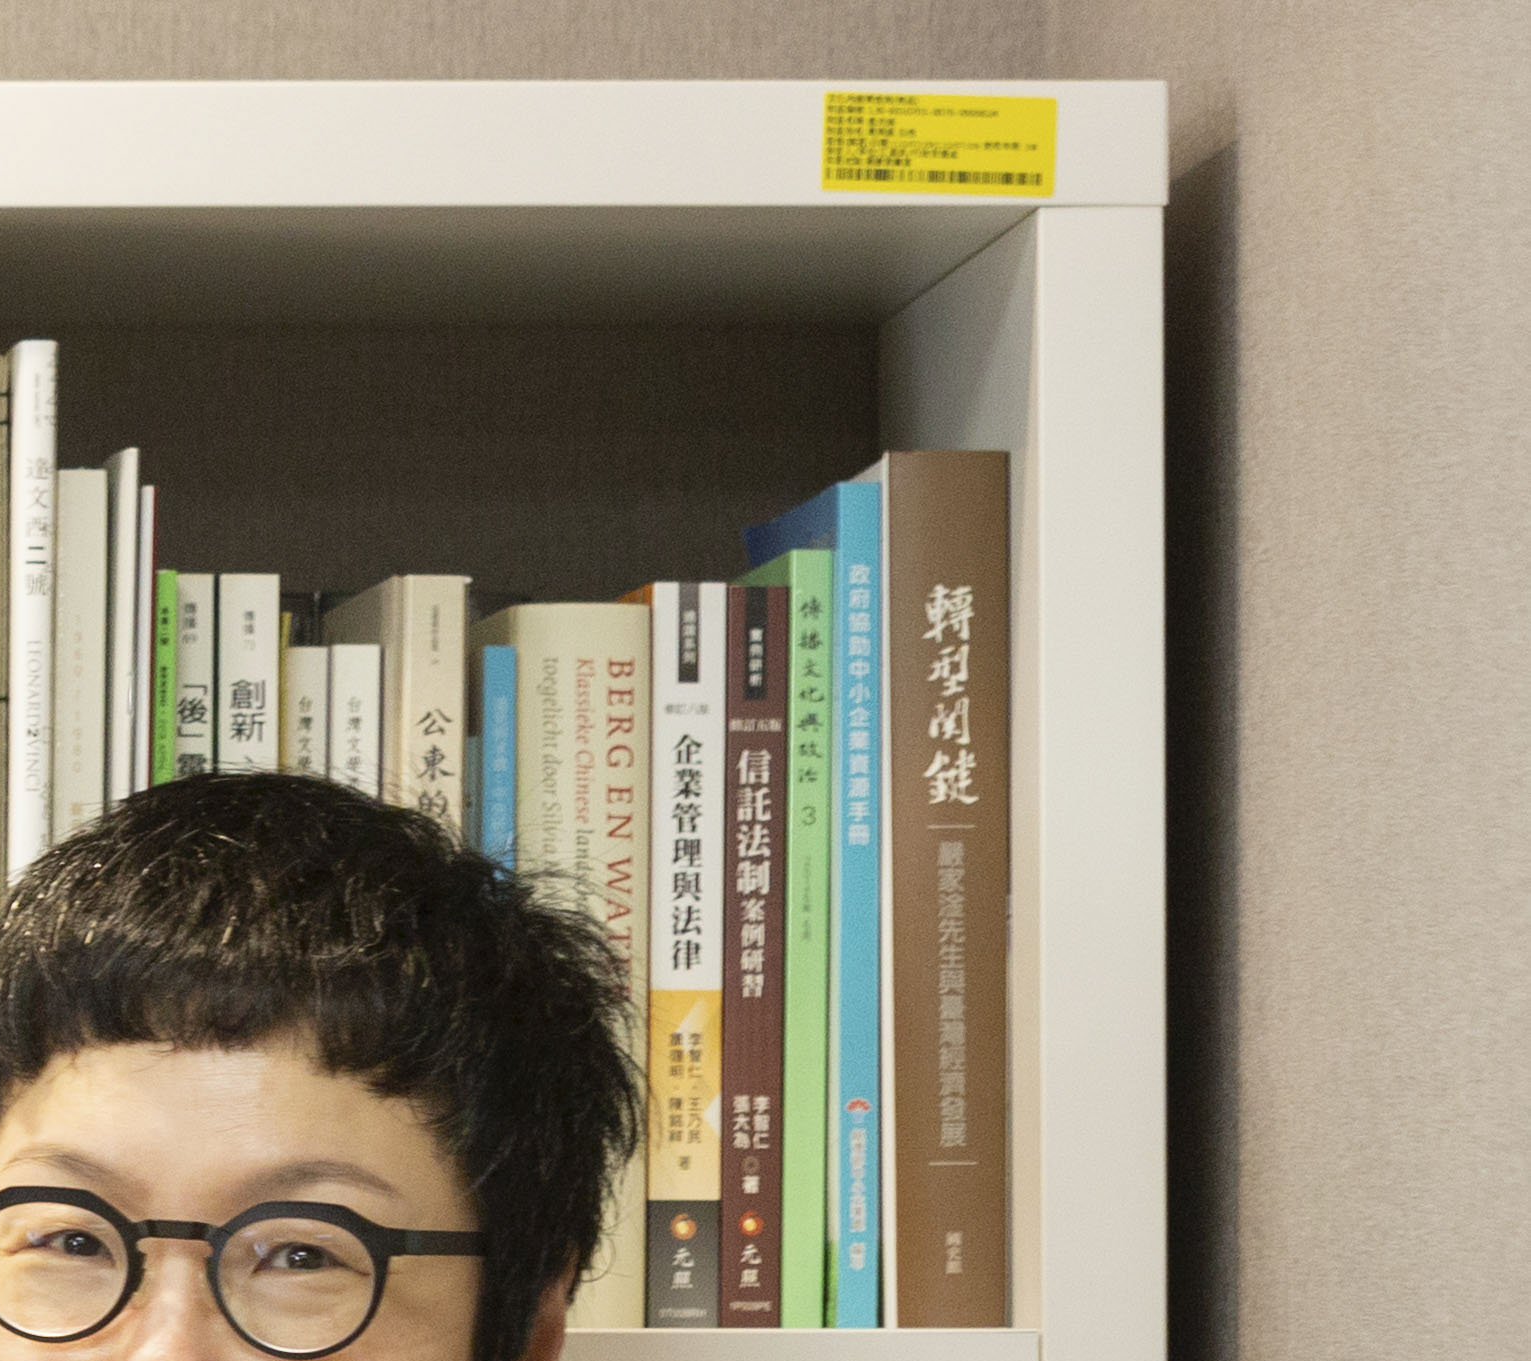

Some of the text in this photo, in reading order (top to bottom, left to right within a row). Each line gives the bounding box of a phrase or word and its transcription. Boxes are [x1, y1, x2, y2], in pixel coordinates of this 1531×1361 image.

[24, 457, 49, 598] 達文西二號
[414, 708, 456, 819] 公東的
[537, 657, 564, 854] toegelicht door Silvia
[573, 657, 597, 826] Klassieke Chinese
[606, 657, 637, 841] BERG EN
[847, 562, 872, 847] 政府協助中小企業資源手冊
[921, 583, 980, 805] 轉型關鍵
[671, 734, 704, 972] 企業管理與法律
[736, 749, 772, 999] 信託法制案例研習
[802, 805, 817, 827] 3
